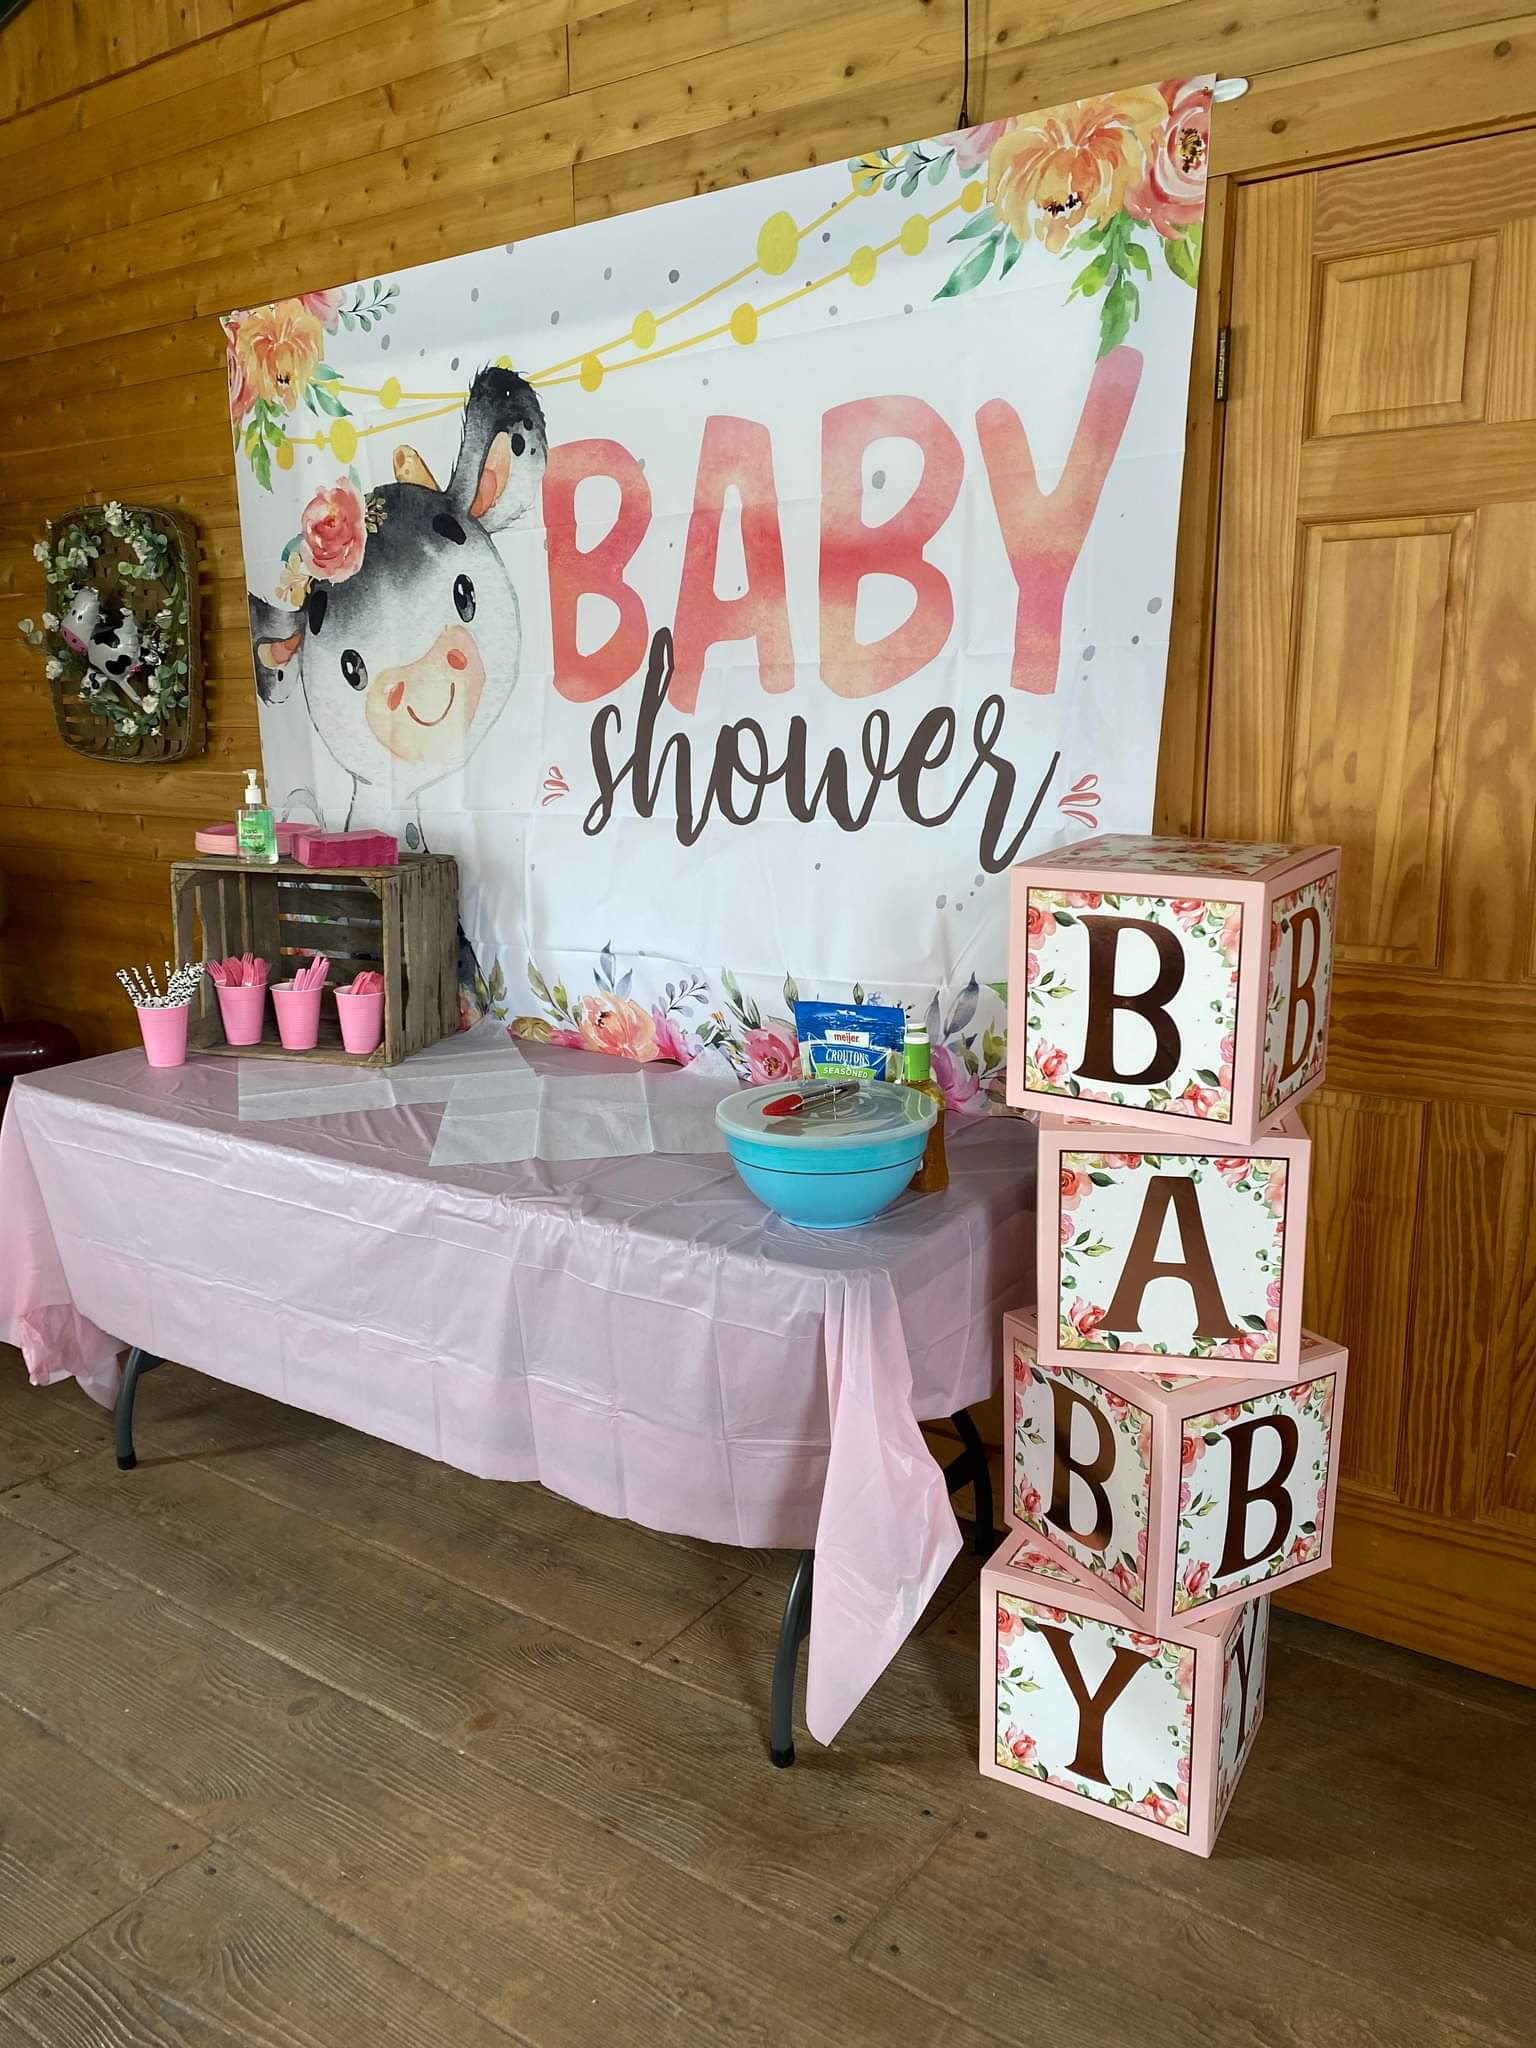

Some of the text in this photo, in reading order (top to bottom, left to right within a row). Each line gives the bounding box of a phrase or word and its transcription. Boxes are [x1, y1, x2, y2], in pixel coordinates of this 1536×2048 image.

[542, 345, 1144, 715] BABY
[583, 627, 1060, 873] shower
[822, 1067, 868, 1078] SEASONED
[825, 1048, 870, 1066] CROUTONS
[833, 1032, 860, 1043] meijer
[1071, 914, 1186, 1086] B
[1278, 906, 1322, 1084] B
[1096, 1176, 1248, 1338] A
[1042, 1376, 1117, 1552] B
[1212, 1413, 1300, 1579] B
[1037, 1623, 1153, 1786] Y
